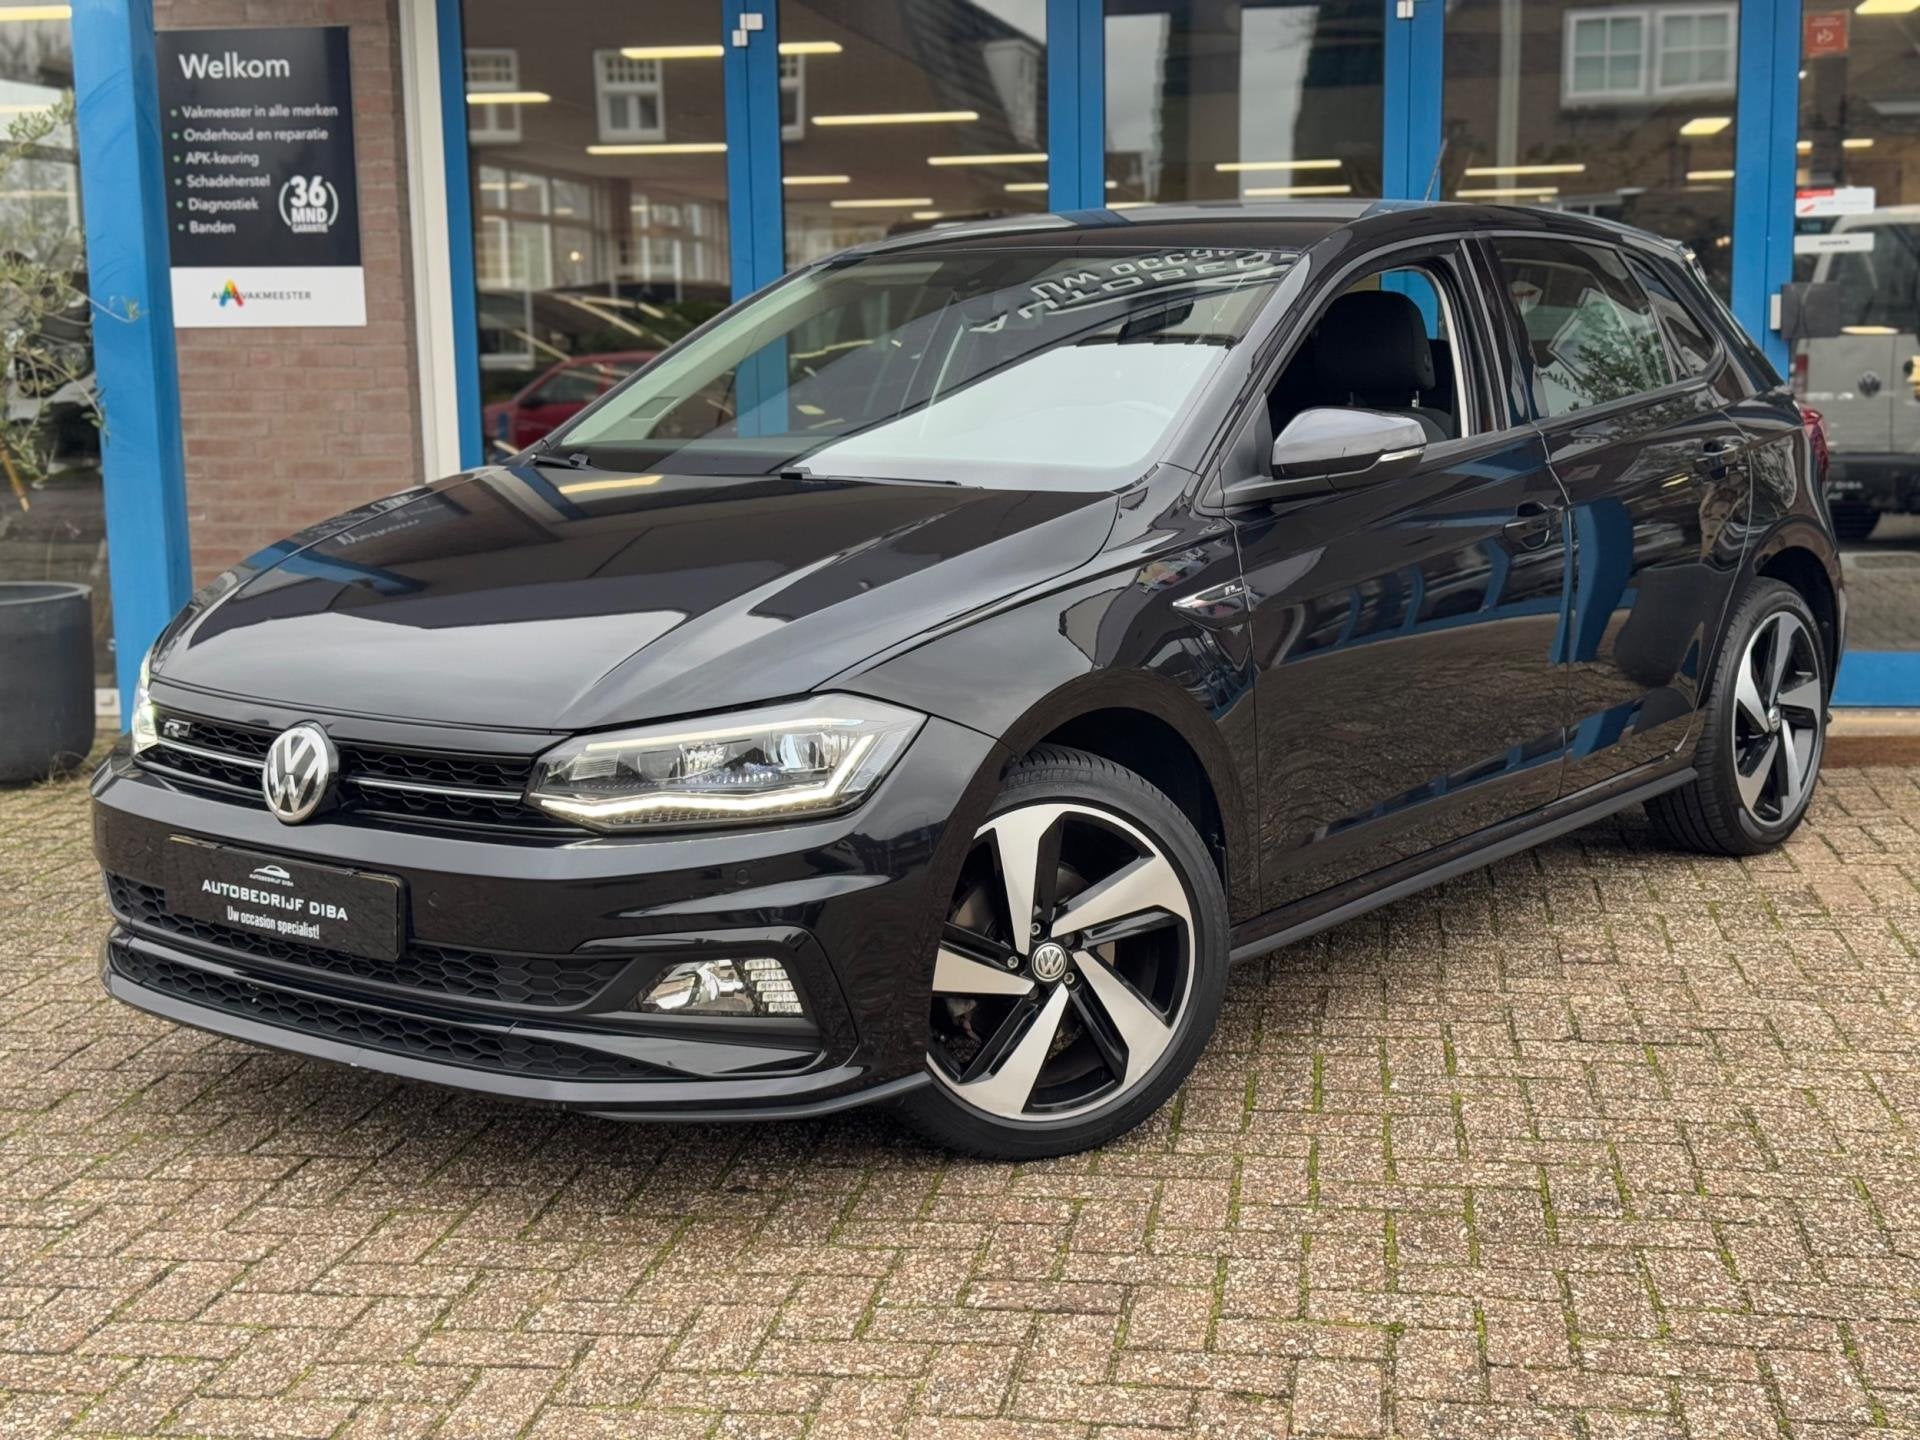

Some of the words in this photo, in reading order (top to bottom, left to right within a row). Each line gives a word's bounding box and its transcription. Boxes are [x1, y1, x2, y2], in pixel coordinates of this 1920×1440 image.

[178, 52, 290, 79] Welkom
[181, 105, 252, 119] Vakmeester
[254, 105, 266, 117] in
[269, 104, 290, 117] alle
[292, 103, 338, 117] merken
[183, 128, 254, 142] Onderhoud
[256, 131, 272, 140] en
[274, 128, 328, 143] reparatie
[185, 152, 260, 167] APK-keuring
[186, 174, 271, 188] Schadeherstel
[290, 175, 327, 207] 36
[188, 198, 259, 214] Diagnostiek
[291, 207, 328, 223] MND
[189, 221, 236, 234] Banden
[202, 879, 304, 911] AUTOBEDRIJF
[309, 901, 348, 921] DIBA
[227, 905, 240, 922] Uw
[240, 912, 276, 930] occasion
[277, 920, 320, 940] specialist!
